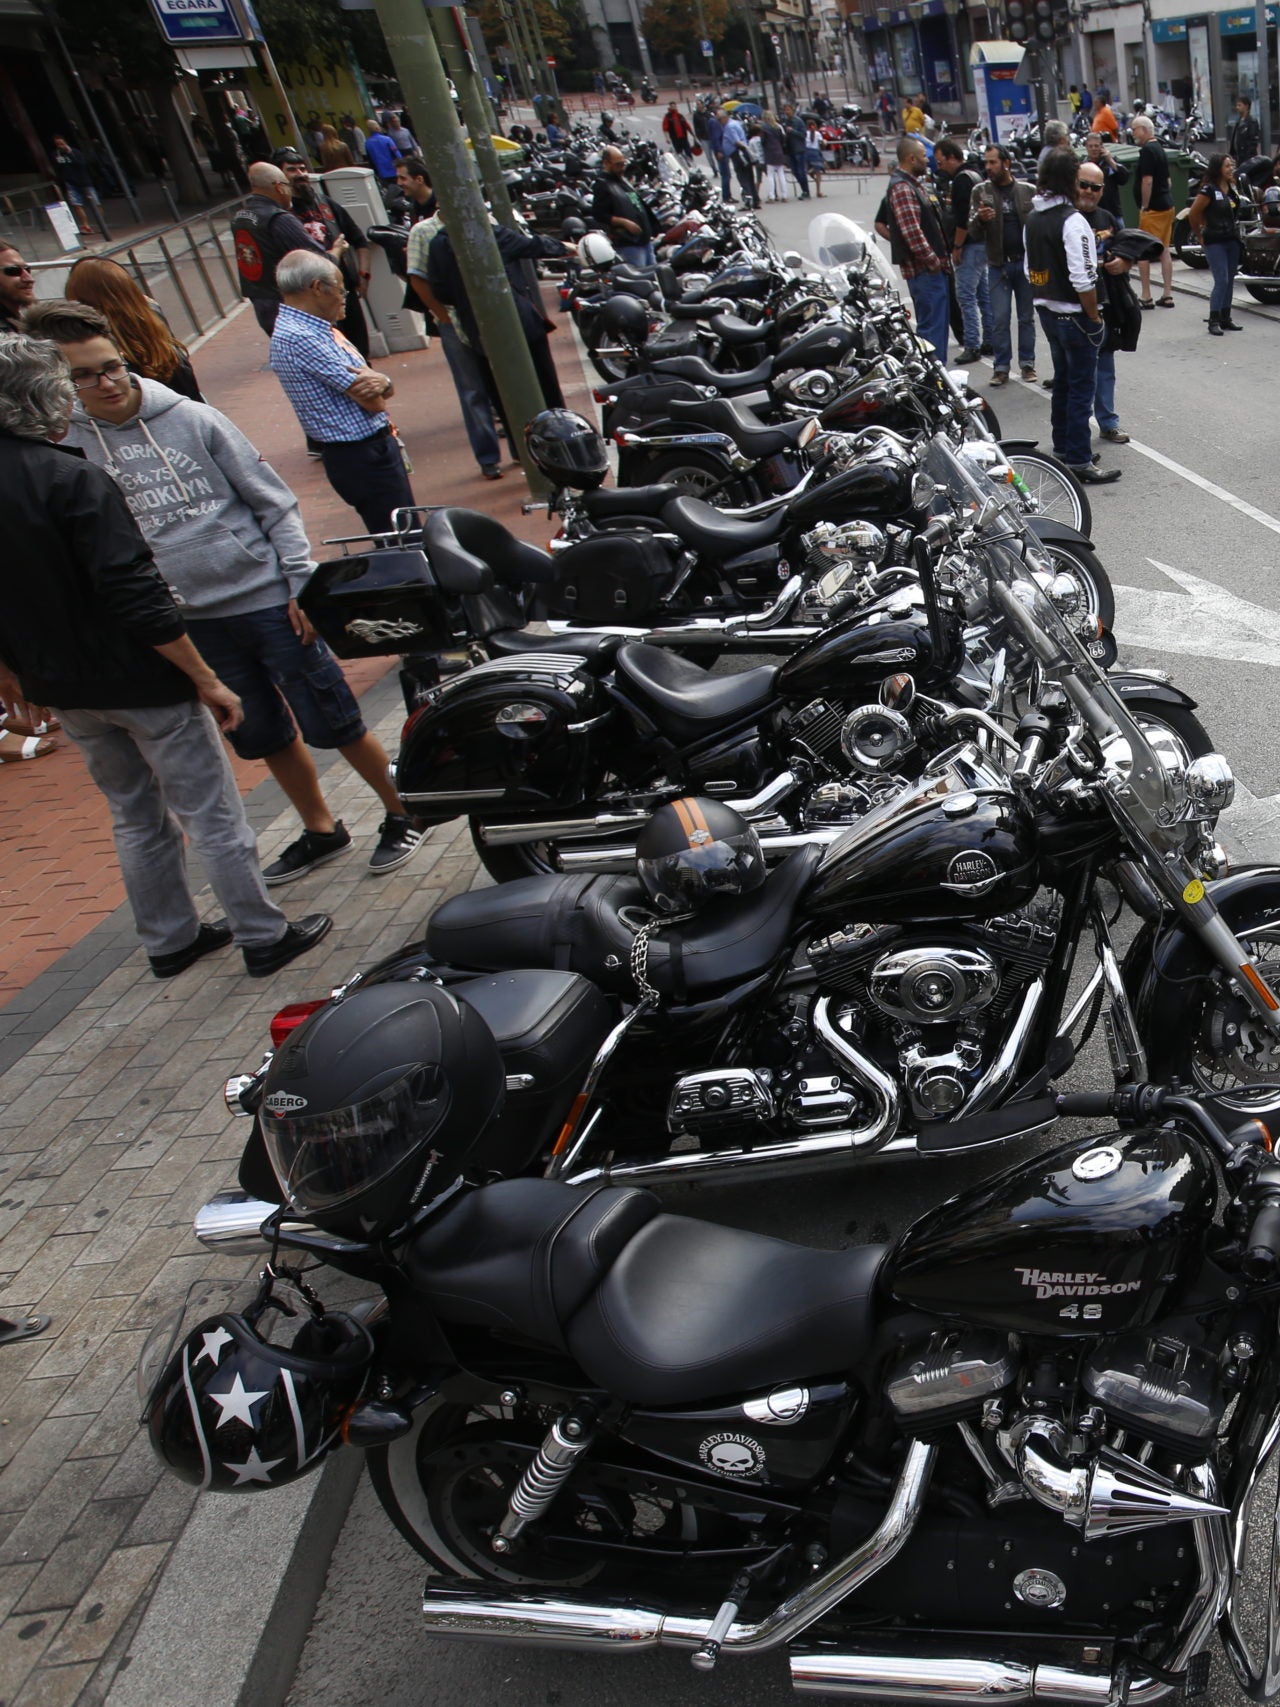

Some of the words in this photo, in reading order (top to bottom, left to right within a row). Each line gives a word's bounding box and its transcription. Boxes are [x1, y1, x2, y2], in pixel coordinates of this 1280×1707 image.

[167, 0, 218, 10] EGARA
[163, 447, 203, 474] CITY
[1014, 1267, 1107, 1286] HARLEY-
[1036, 1280, 1141, 1299] DAVIDSON
[1059, 1303, 1103, 1319] 48
